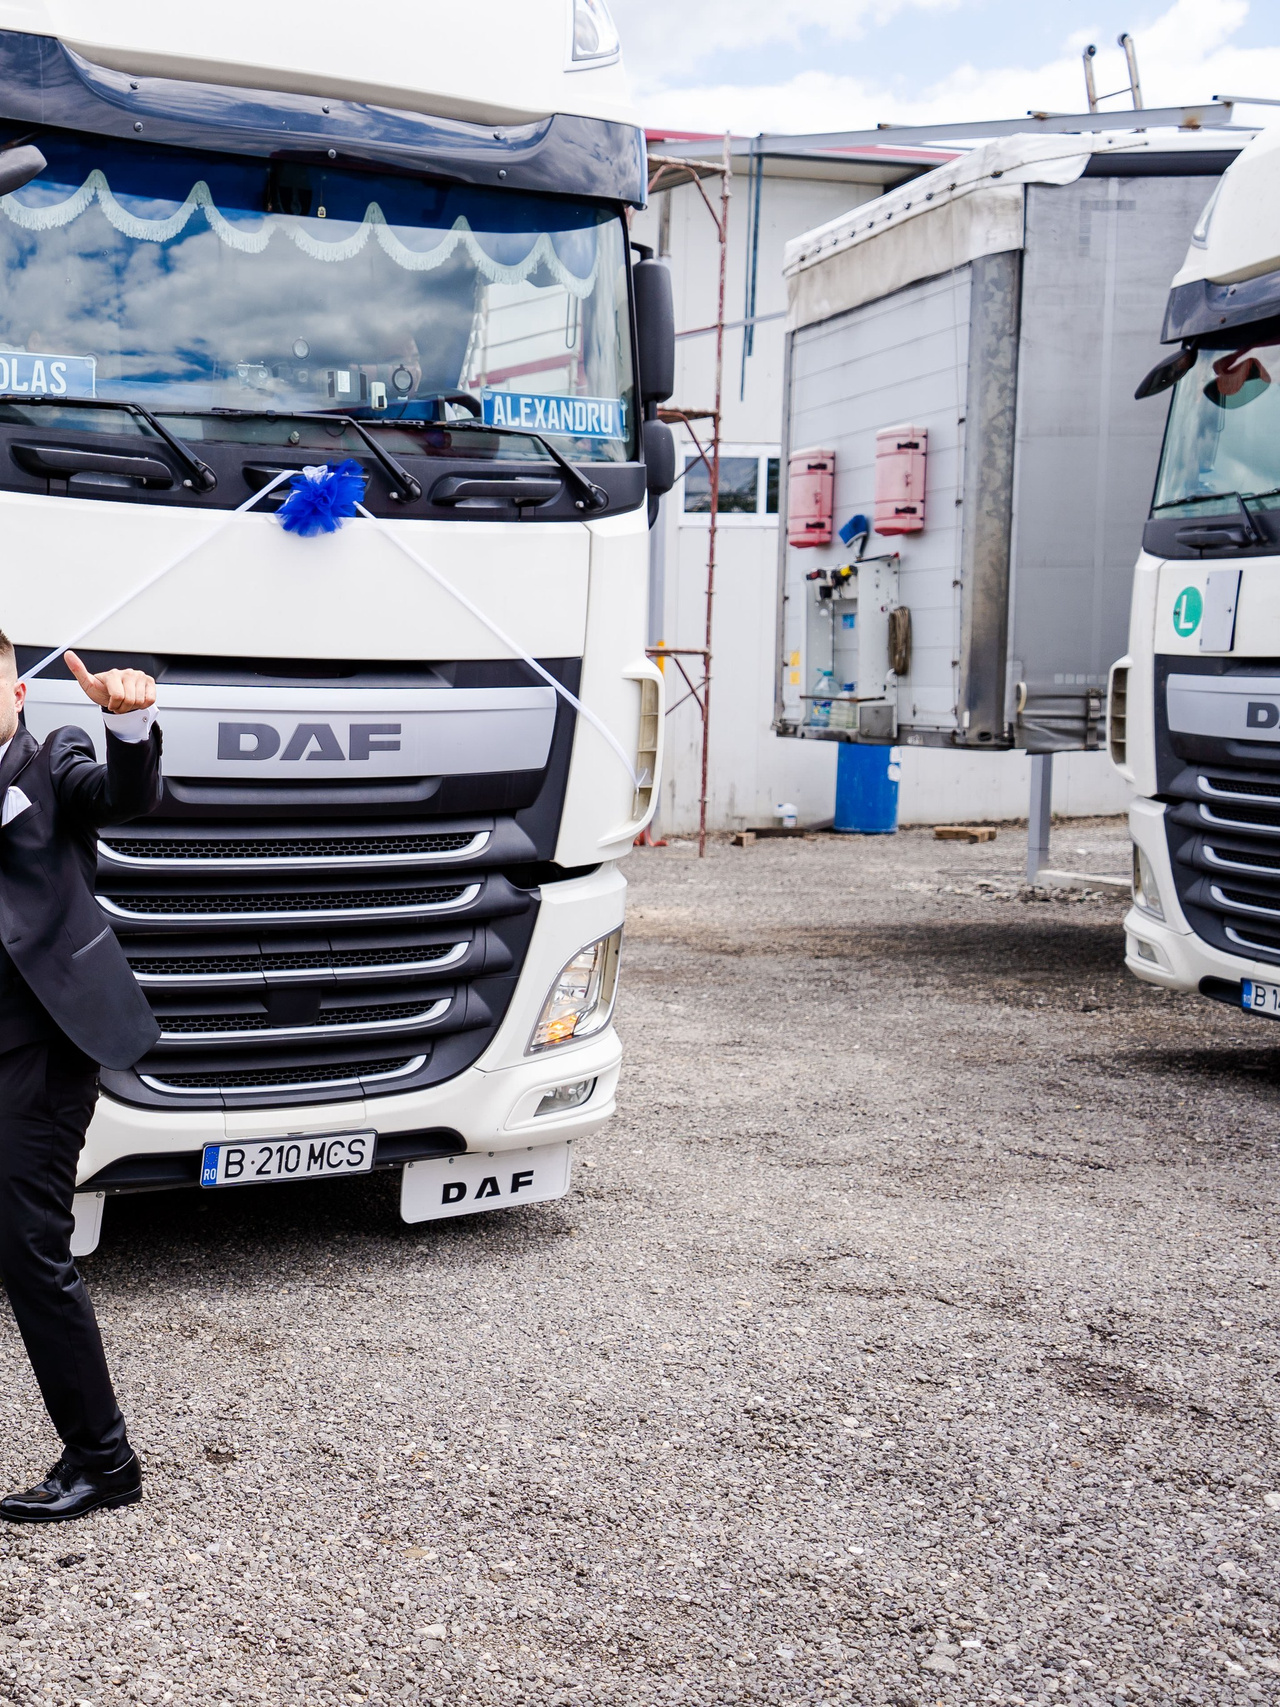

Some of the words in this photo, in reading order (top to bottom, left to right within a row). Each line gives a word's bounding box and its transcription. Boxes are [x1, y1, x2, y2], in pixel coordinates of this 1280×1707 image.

[493, 395, 613, 434] ALEXANDRU
[1179, 595, 1193, 629] L
[1246, 701, 1280, 729] D
[217, 722, 402, 761] DAF
[1254, 984, 1266, 1007] B
[203, 1168, 216, 1181] RO
[224, 1149, 246, 1178] B
[255, 1144, 301, 1176] 210
[306, 1138, 366, 1172] MCS
[441, 1169, 535, 1205] DAF
